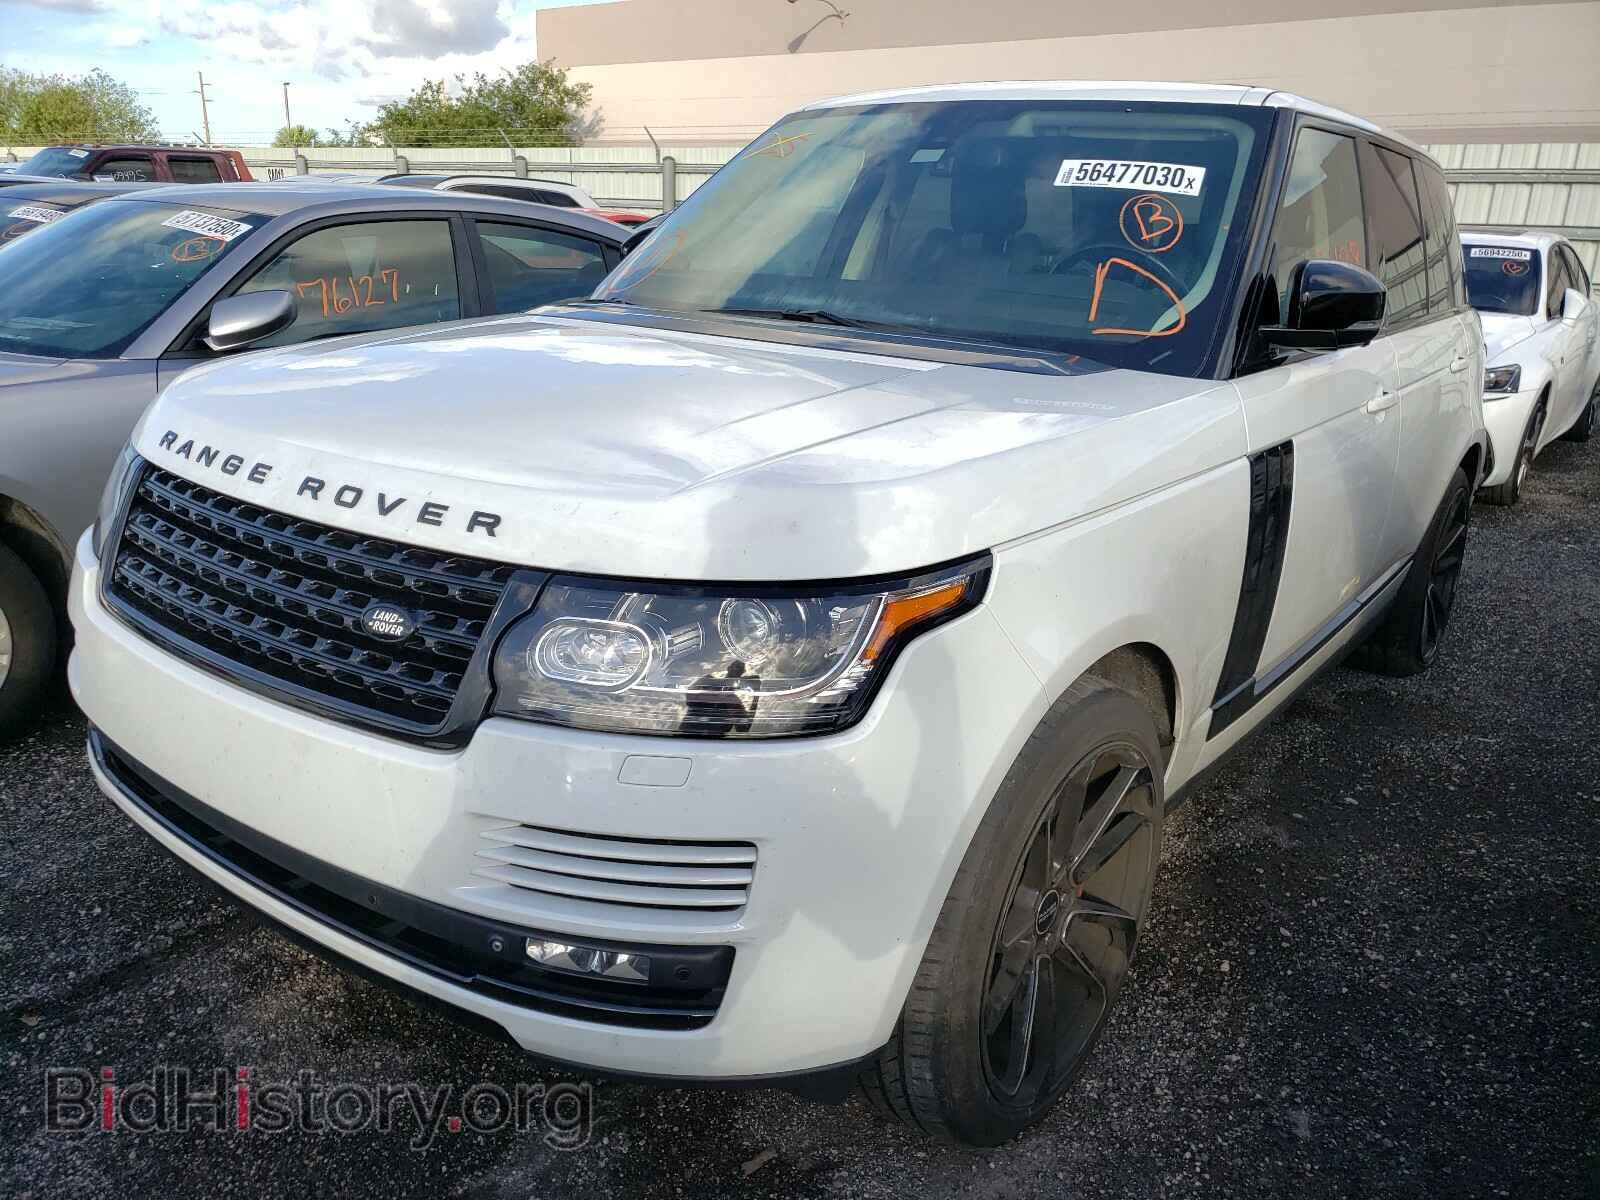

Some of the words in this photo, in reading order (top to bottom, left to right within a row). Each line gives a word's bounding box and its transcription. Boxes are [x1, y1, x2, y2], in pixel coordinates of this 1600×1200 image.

[1133, 201, 1174, 241] B
[296, 268, 398, 320] 76127
[1088, 256, 1187, 337] D
[158, 430, 273, 485] RANGE
[296, 476, 502, 537] ROVER
[372, 609, 399, 623] LAND
[373, 620, 404, 636] ROVER
